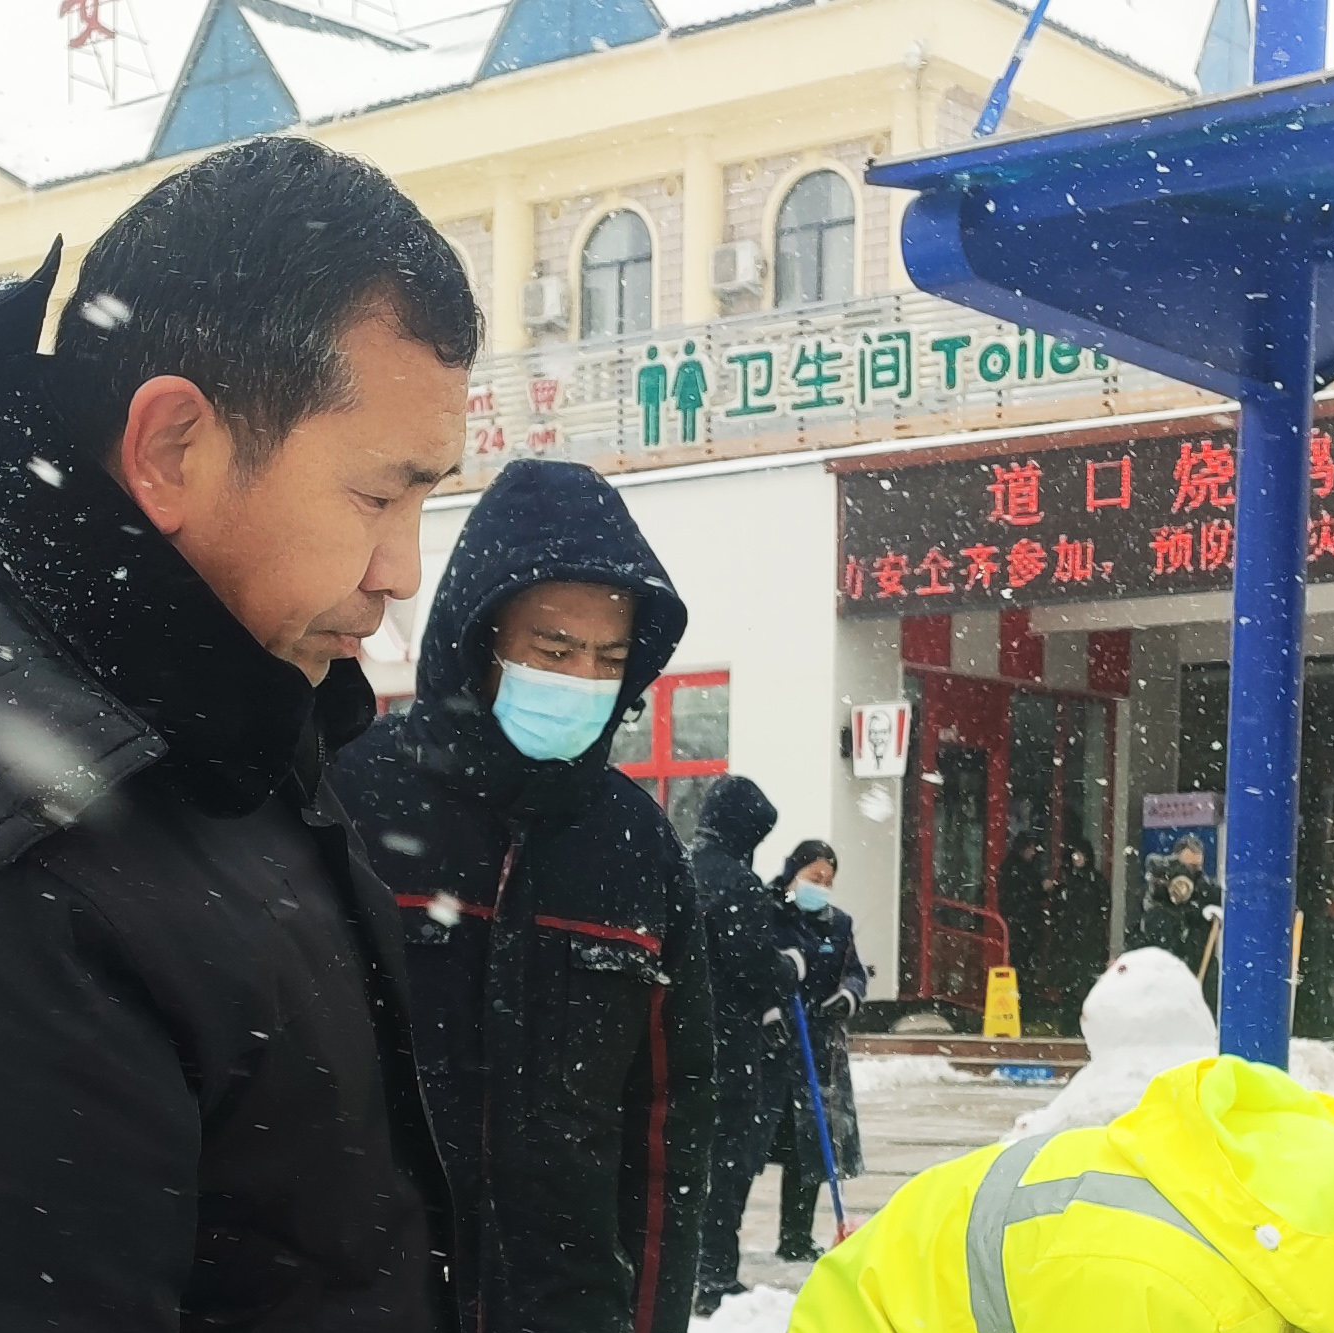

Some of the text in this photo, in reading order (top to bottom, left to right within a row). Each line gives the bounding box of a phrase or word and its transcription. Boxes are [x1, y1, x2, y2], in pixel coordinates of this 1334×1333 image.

[726, 331, 911, 417] 卫生间
[475, 427, 505, 454] 24
